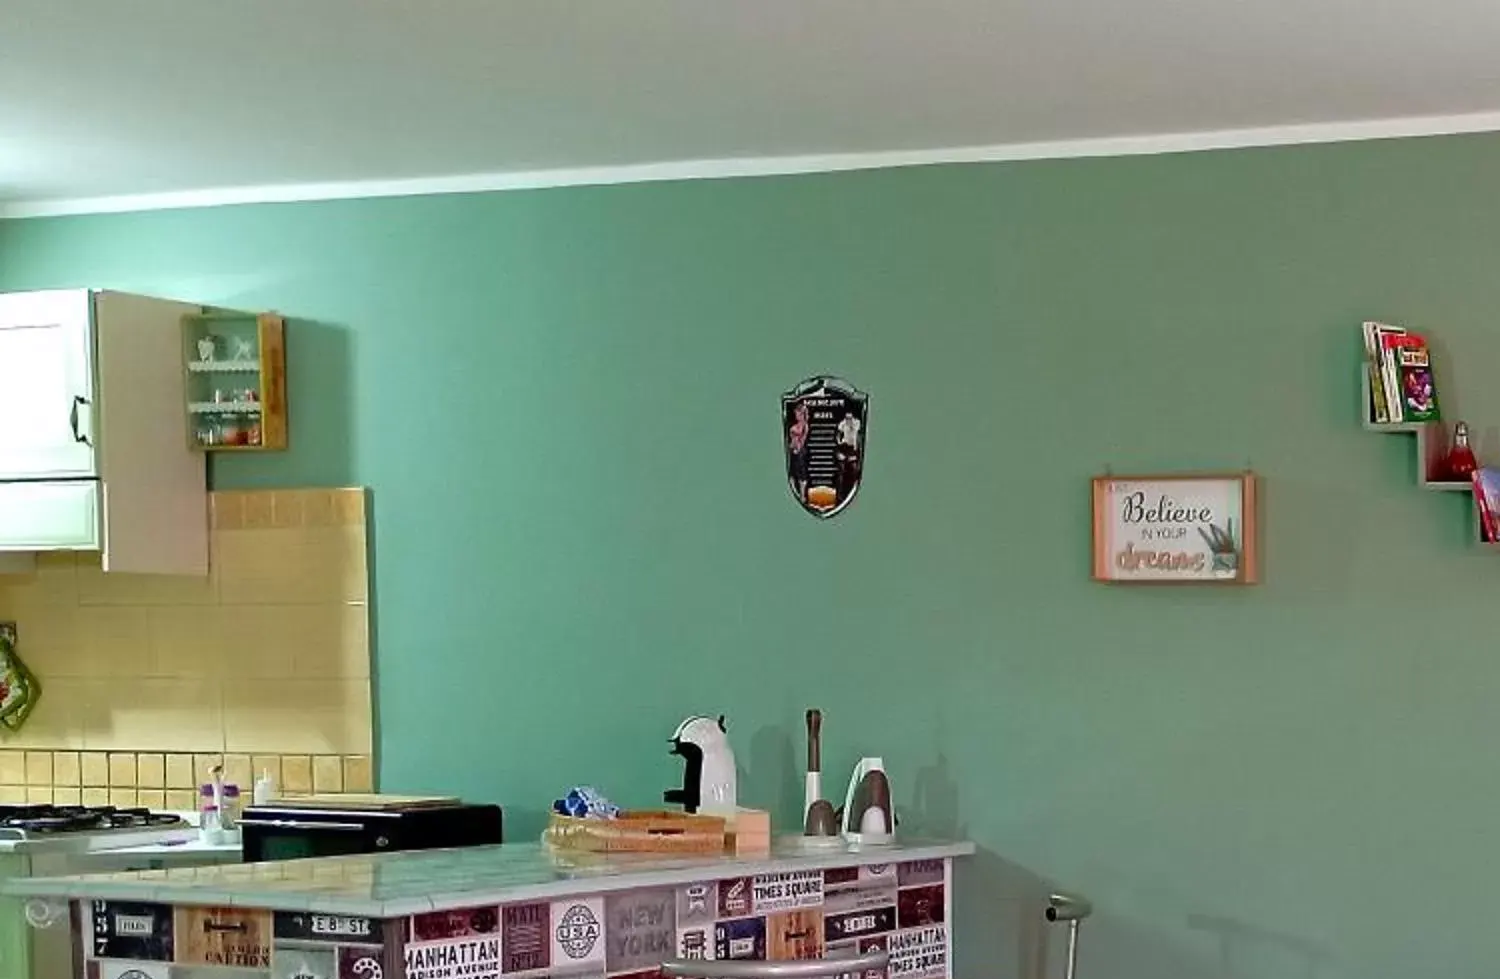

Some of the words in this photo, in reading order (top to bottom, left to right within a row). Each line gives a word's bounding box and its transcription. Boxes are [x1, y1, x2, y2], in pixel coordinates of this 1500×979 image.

[1123, 491, 1213, 524] Believe
[1141, 529, 1153, 539] IN
[1155, 527, 1187, 539] YOUR
[1116, 542, 1205, 572] dreams
[754, 885, 783, 899] TIMES
[785, 879, 823, 899] SQUARE
[620, 902, 667, 929] NEW
[348, 919, 366, 933] ST
[559, 925, 598, 939] USA
[619, 930, 673, 957] YORK
[455, 961, 499, 976] AVENUE
